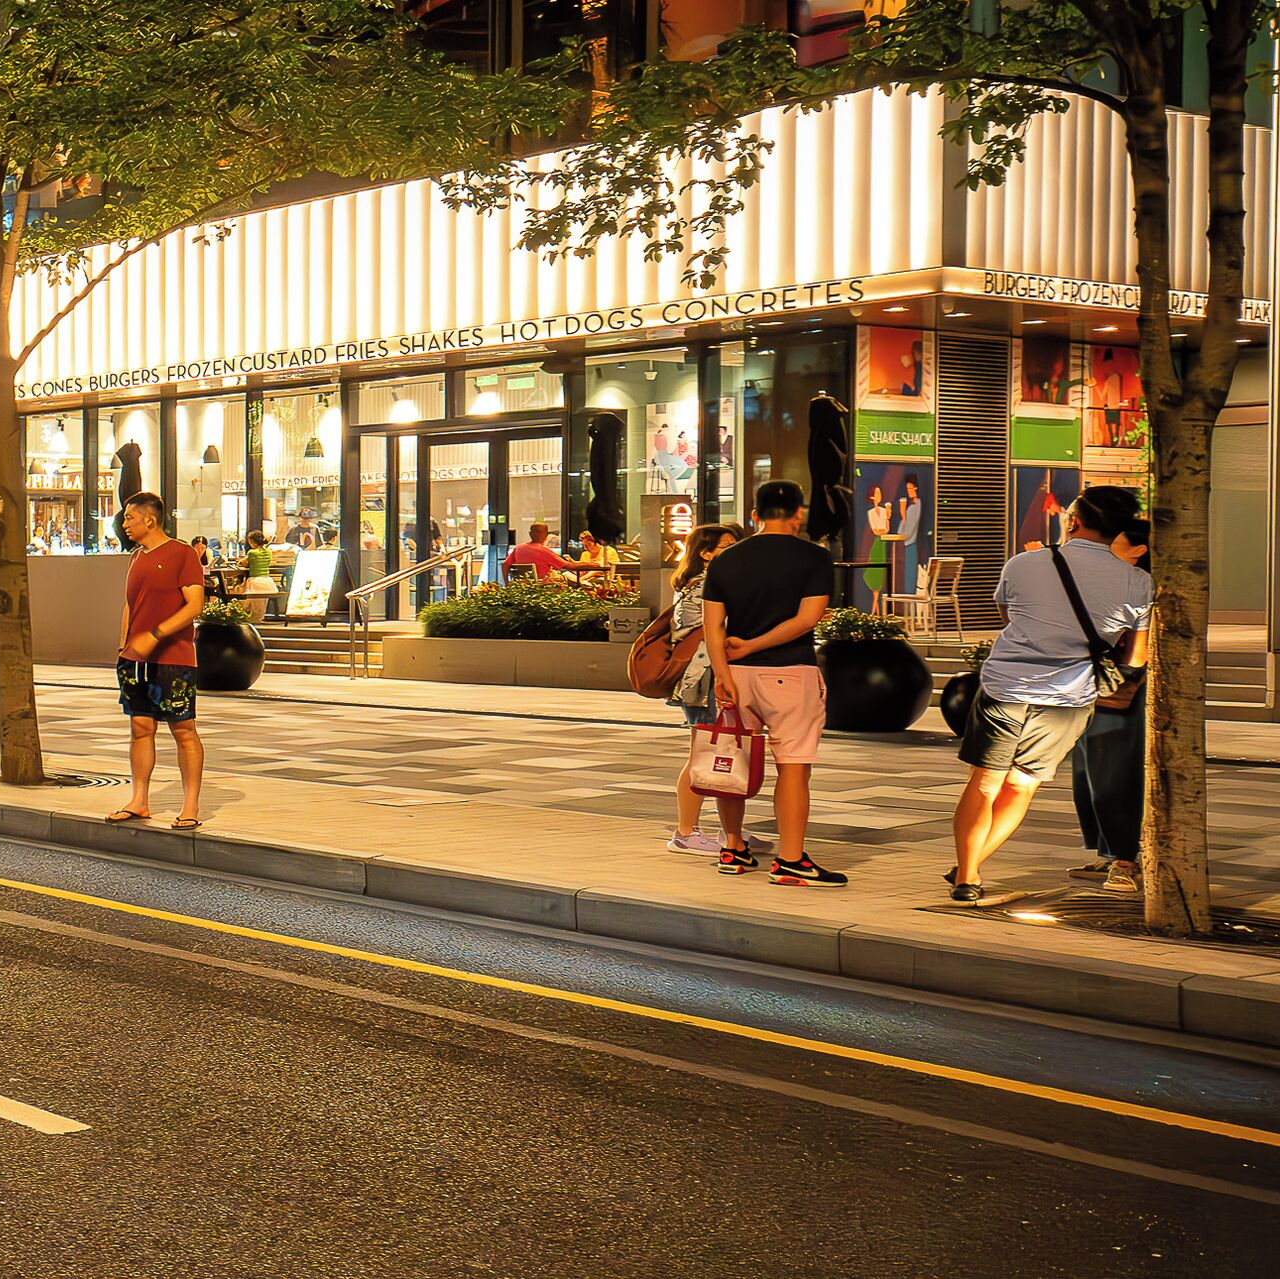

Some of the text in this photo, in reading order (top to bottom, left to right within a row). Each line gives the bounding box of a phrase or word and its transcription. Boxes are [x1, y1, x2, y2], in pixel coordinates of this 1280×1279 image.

[984, 272, 1056, 300] BURGERS
[1062, 280, 1121, 306] FROZEN
[1124, 287, 1188, 315] CURD
[1243, 300, 1271, 321] HAK
[31, 377, 82, 398] CONES
[89, 368, 160, 392] BURGERS
[167, 358, 236, 382] FROZEN
[239, 347, 327, 373] CUSTARD
[335, 340, 389, 362] FRIES
[399, 328, 484, 355] SHAKES
[500, 319, 557, 343] HOT
[565, 308, 644, 333] DOGS
[662, 279, 865, 325] CONCRETES
[869, 430, 934, 446] SHAKE SHACK
[264, 477, 308, 488] USTARD
